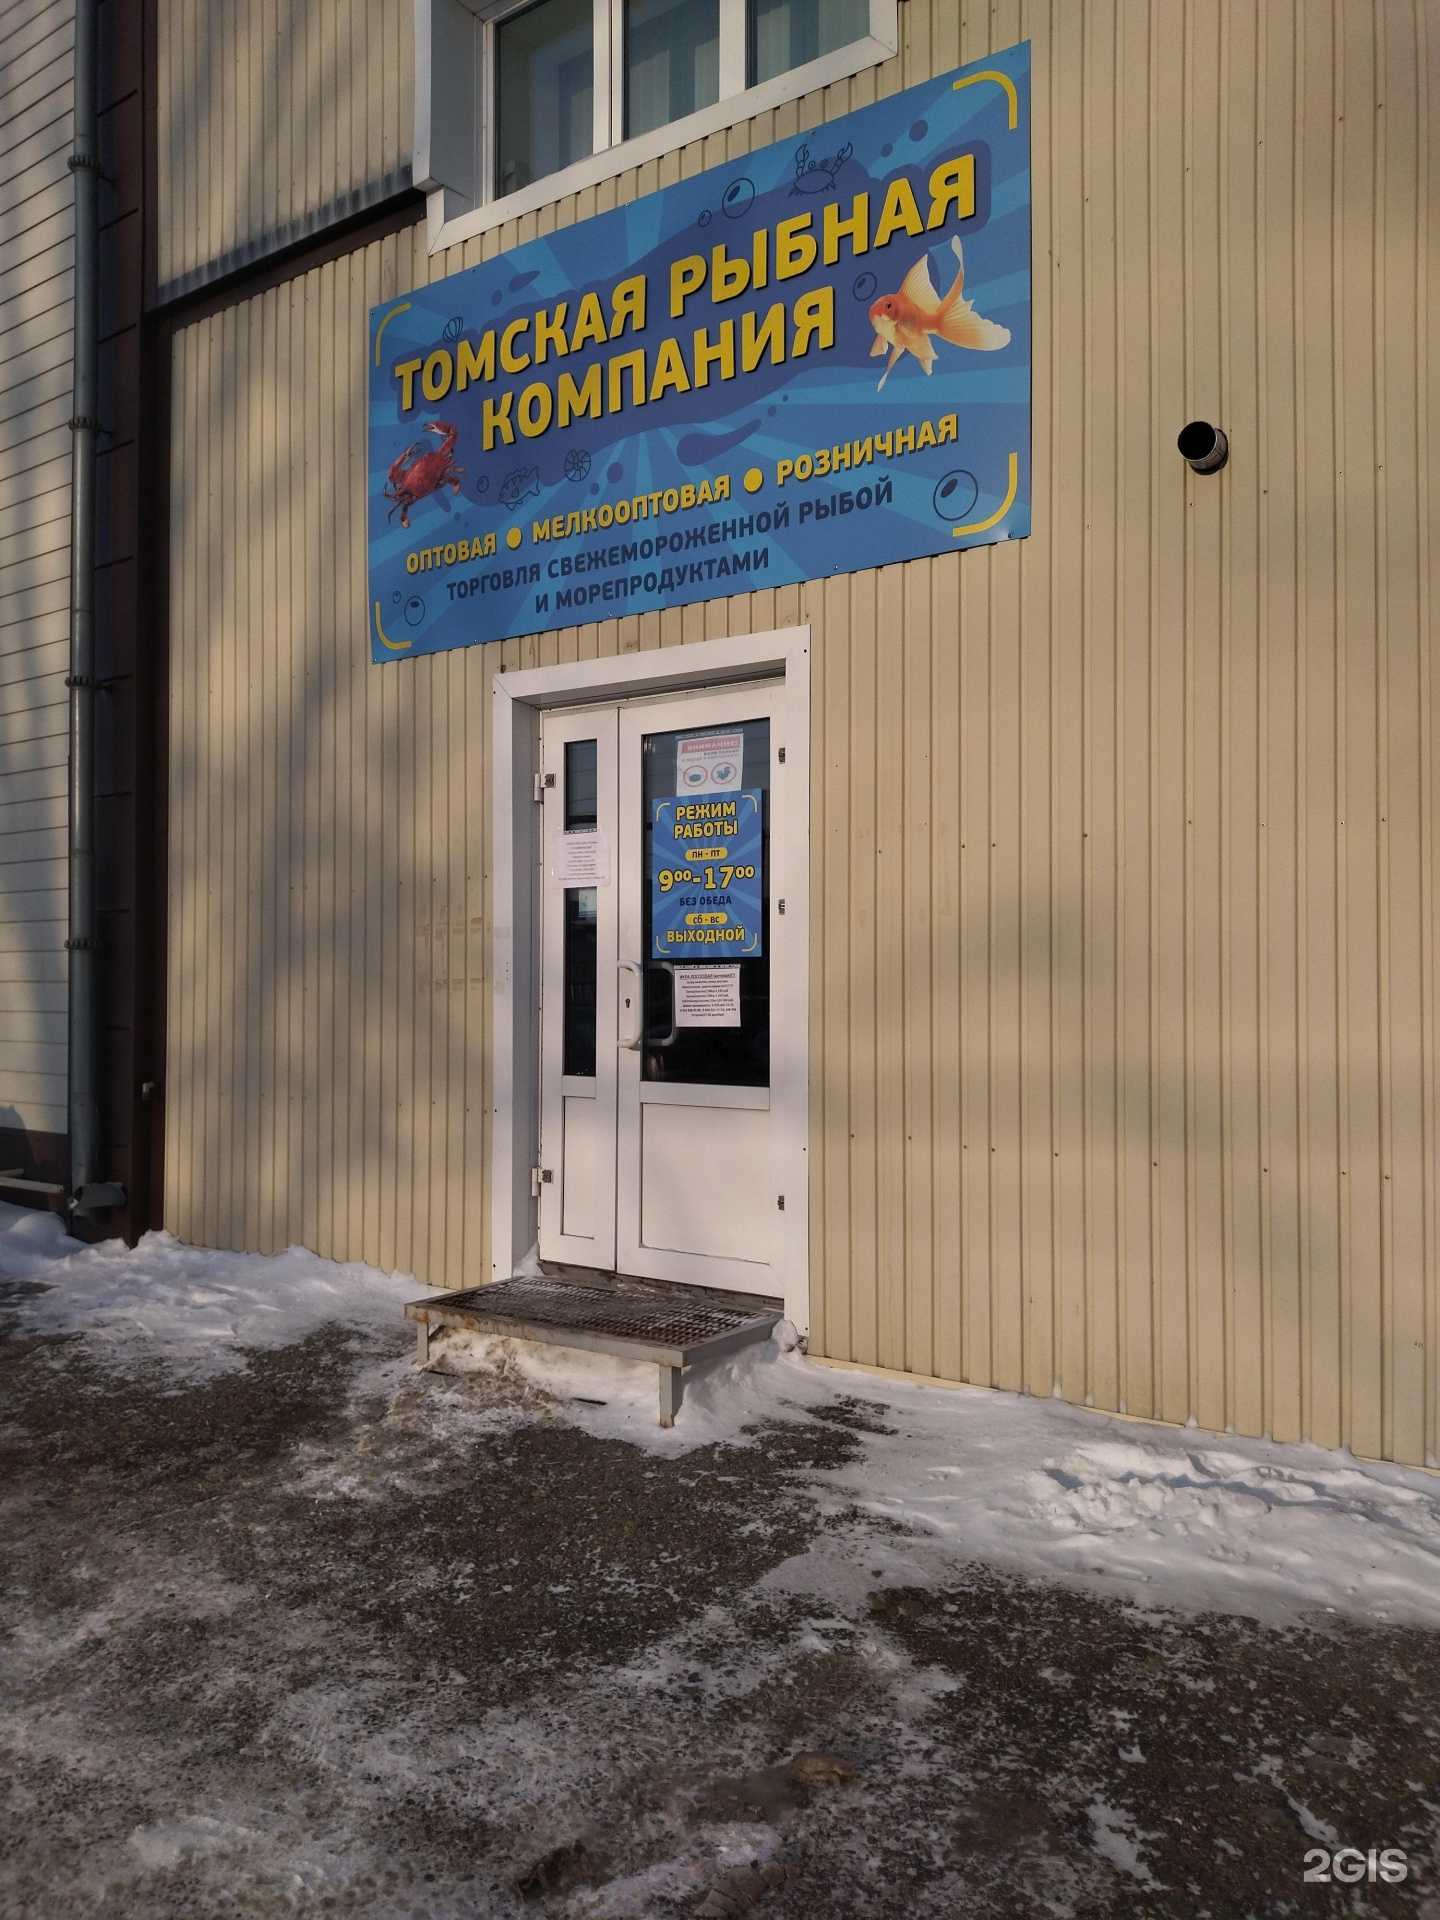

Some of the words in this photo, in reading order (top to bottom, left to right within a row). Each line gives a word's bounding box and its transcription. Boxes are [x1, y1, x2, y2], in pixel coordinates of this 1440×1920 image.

[393, 275, 647, 411] ТОМСКАЯ
[669, 154, 977, 320] РЫБНАЯ
[481, 287, 835, 451] КОМПАНИЯ
[405, 533, 497, 575] ОПТОВАЯ
[532, 476, 731, 545] МЕЛКООПТОВАЯ
[776, 414, 959, 487] РОЗНИЧНАЯ
[446, 563, 541, 602] ТОРГОВЛЯ
[548, 499, 790, 581] СВЕЖЕМОРОЖЕННОЙ
[798, 477, 893, 525] РЫБОЙ
[535, 592, 550, 613] И
[555, 549, 770, 611] МОРЕПРОДУКТАМИ
[674, 820, 738, 839] РАБОТЫ
[676, 801, 736, 821] РЕЖИМ
[679, 896, 697, 906] БЕЗ
[699, 895, 732, 906] ОБЕДА
[666, 926, 746, 944] ВЫХОДНОЙ
